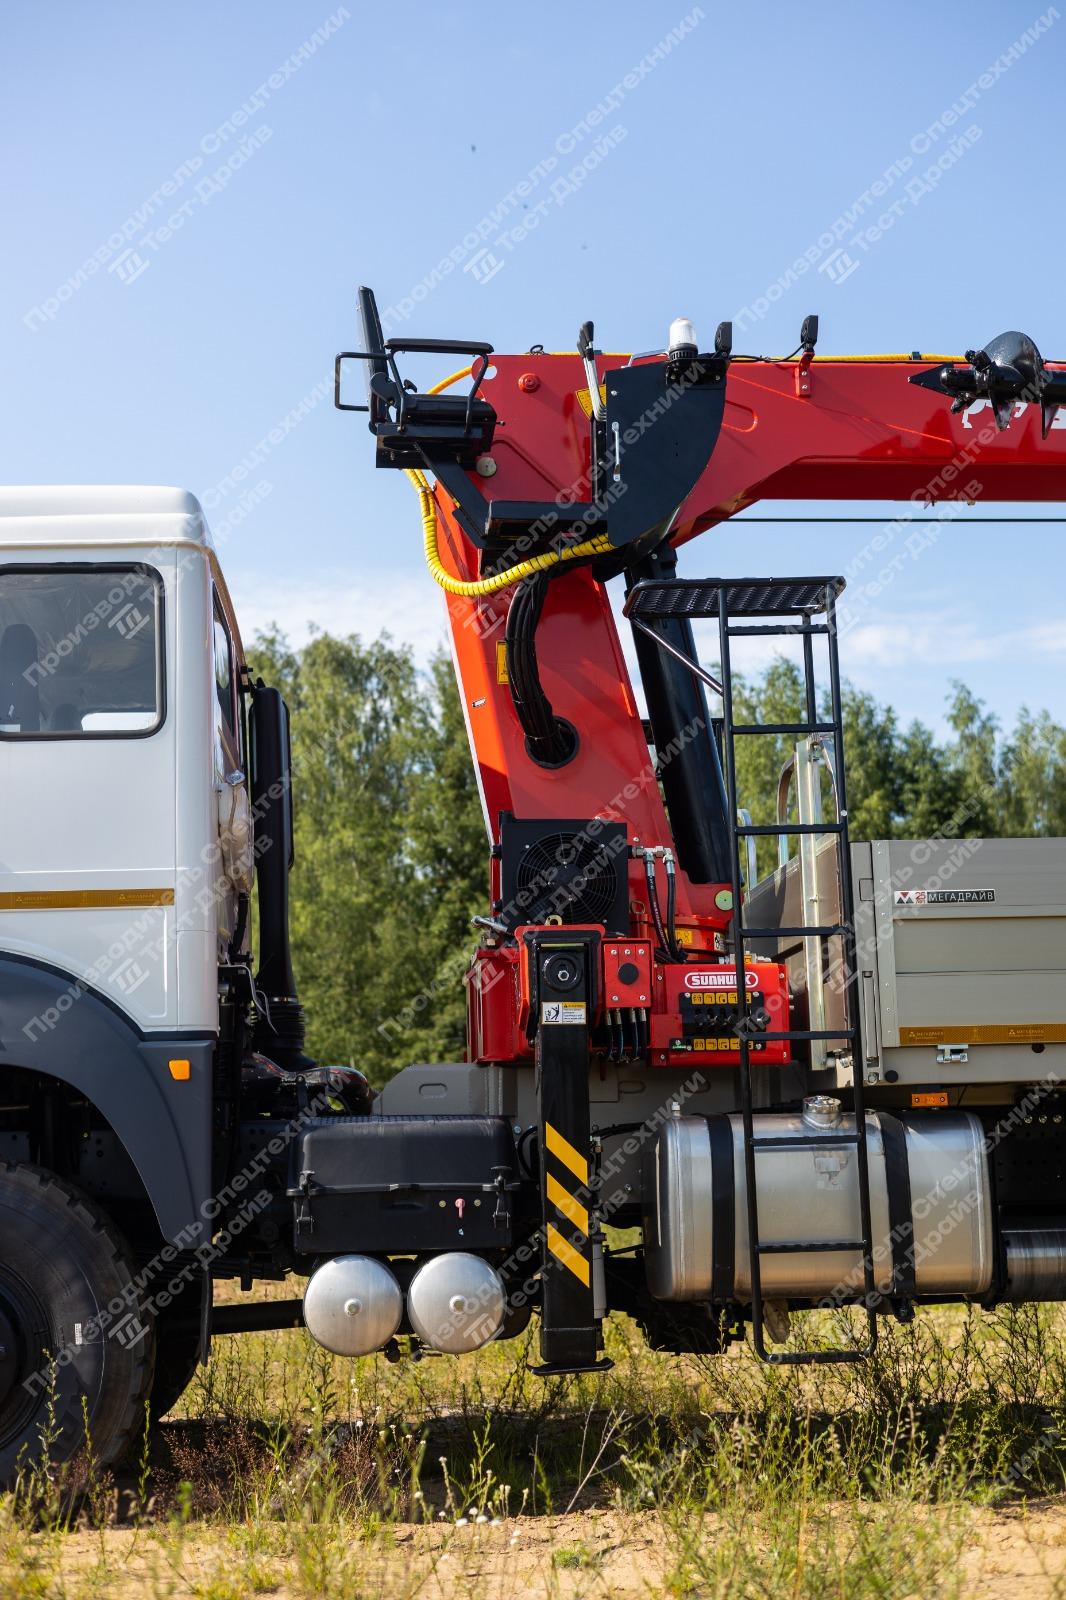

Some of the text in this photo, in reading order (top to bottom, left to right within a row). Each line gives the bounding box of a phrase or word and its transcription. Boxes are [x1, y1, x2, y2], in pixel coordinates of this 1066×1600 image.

[915, 891, 926, 900] 25
[928, 891, 994, 903] МЕГАДРАЙВ
[691, 975, 752, 986] SUNHUK
